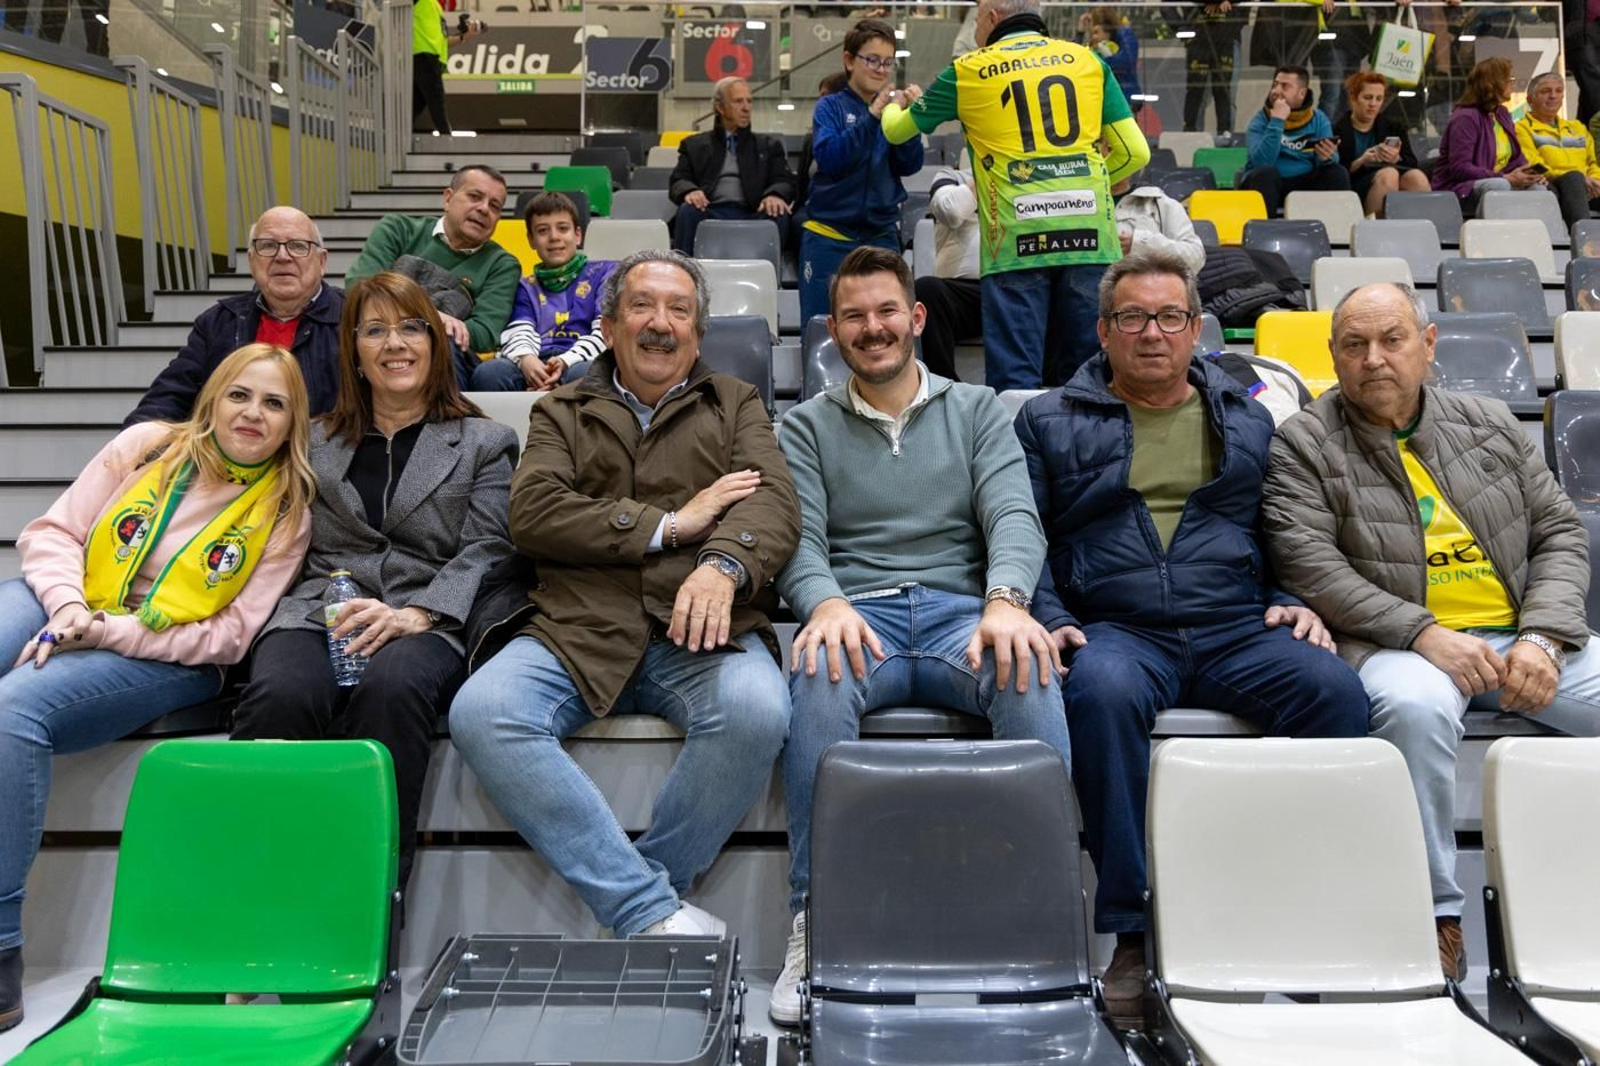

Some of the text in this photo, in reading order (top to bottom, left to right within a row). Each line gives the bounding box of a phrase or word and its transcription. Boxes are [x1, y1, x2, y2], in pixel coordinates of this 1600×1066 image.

[683, 23, 739, 38] Sector
[447, 44, 550, 74] alida
[586, 37, 671, 92] Sector 6
[704, 22, 754, 82] 6
[1518, 37, 1559, 92] 7
[978, 53, 1075, 80] CABALLERO
[499, 81, 533, 92] SALIDA
[1001, 74, 1081, 154] 10
[1059, 160, 1087, 170] RURAL
[1016, 199, 1094, 215] Campoameno
